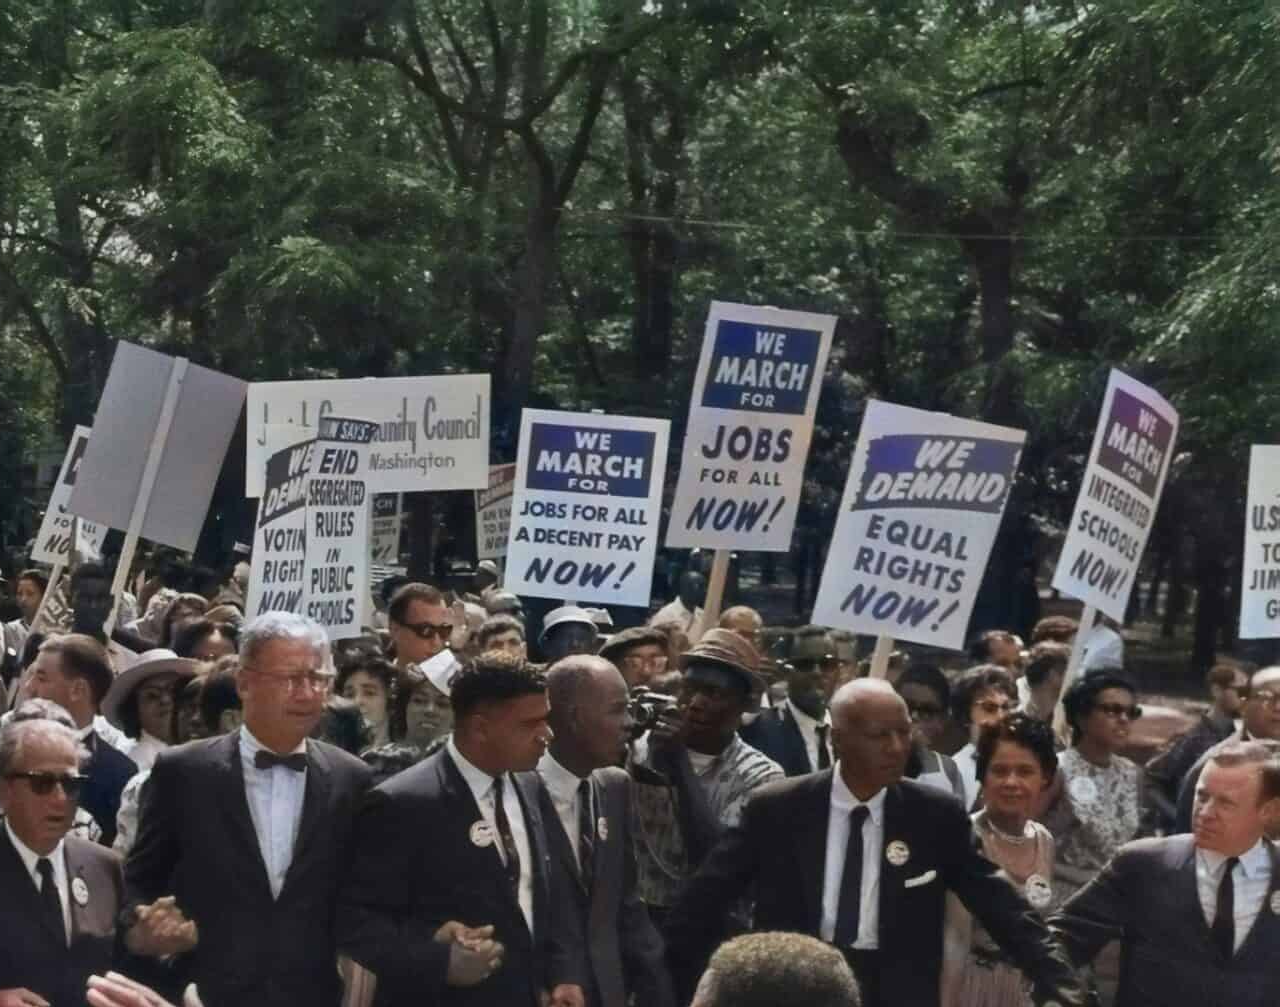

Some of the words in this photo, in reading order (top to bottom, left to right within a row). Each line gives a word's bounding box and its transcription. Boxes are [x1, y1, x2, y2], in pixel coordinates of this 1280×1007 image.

[755, 330, 787, 355] WE
[715, 357, 809, 392] MARCH
[740, 392, 775, 408] FOR
[423, 393, 481, 441] Council
[1138, 407, 1158, 437] WE
[574, 431, 612, 451] WE
[702, 424, 793, 464] JOBS
[915, 439, 976, 470] WE
[1107, 421, 1163, 476] MARCH
[320, 448, 358, 474] END
[536, 451, 644, 479] MARCH
[1121, 461, 1143, 485] FOR
[567, 478, 609, 492] FOR
[699, 468, 738, 484] FOR
[749, 471, 782, 487] ALL
[866, 472, 1007, 503] DEMAND
[309, 479, 366, 506] SEGREGATED
[1087, 474, 1151, 529] INTEGRATED
[315, 511, 354, 538] RULES
[520, 500, 567, 519] JOBS
[572, 504, 609, 522] FOR
[617, 508, 648, 525] ALL
[685, 495, 785, 533] NOW!
[263, 528, 305, 553] VOTIN
[514, 526, 530, 543] A
[533, 528, 603, 548] DECENT
[608, 535, 645, 552] PAY
[866, 514, 970, 561] EQUAL
[1078, 510, 1140, 563] SCHOOLS
[325, 548, 341, 563] IN
[262, 559, 304, 585] RIGHT
[311, 566, 354, 595] PUBLIC
[524, 557, 636, 589] NOW!
[853, 546, 966, 594] RIGHTS
[1070, 549, 1129, 599] NOW!
[308, 598, 354, 626] SCHOOLS
[840, 583, 961, 632] NOW!
